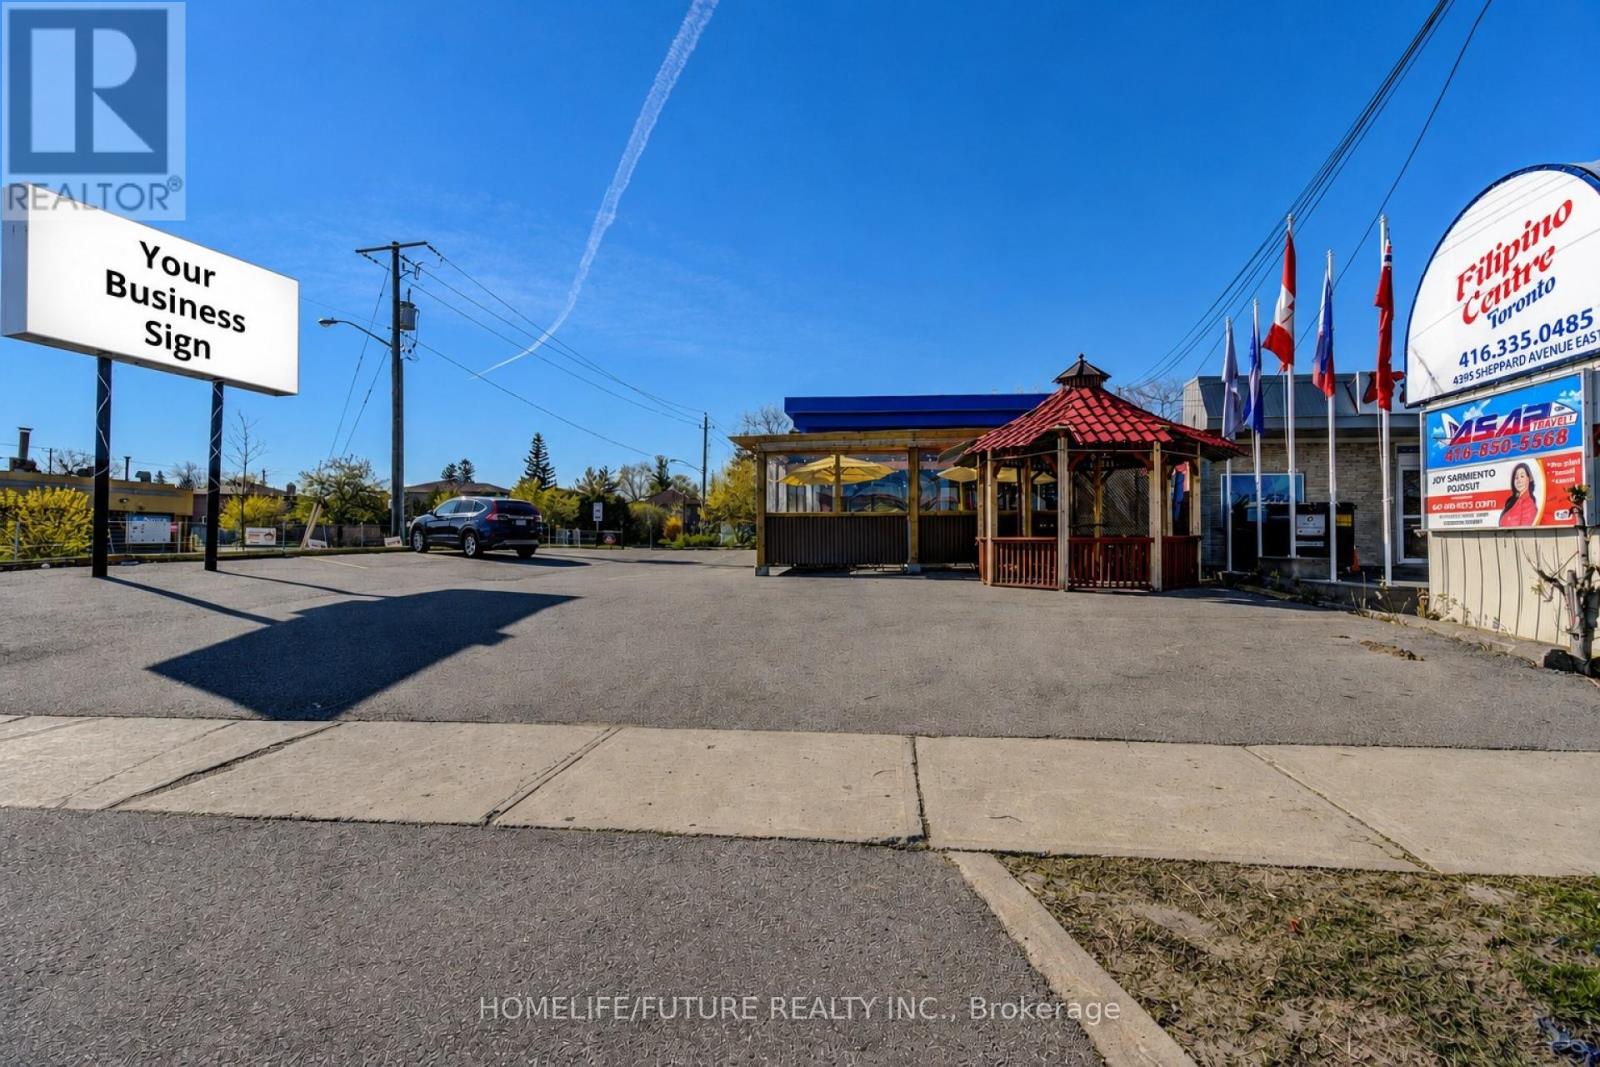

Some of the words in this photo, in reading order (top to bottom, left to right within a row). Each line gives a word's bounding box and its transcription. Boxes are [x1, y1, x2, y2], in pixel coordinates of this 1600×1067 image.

[139, 240, 216, 288] Your
[1456, 199, 1573, 302] Filipino
[105, 269, 246, 333] Business
[1462, 245, 1555, 325] Centre
[1487, 276, 1556, 329] Toronto
[144, 320, 212, 361] Sign
[1453, 372, 1475, 385] 4395
[1476, 354, 1526, 379] SHEPPARD
[1528, 338, 1574, 363] AVENUE
[1459, 307, 1594, 368] 416.335.0485
[1445, 428, 1569, 462] 416-850-5568
[1449, 402, 1552, 446] ASAP
[1432, 475, 1446, 484] JOY
[1447, 469, 1496, 482] SARMIENTO
